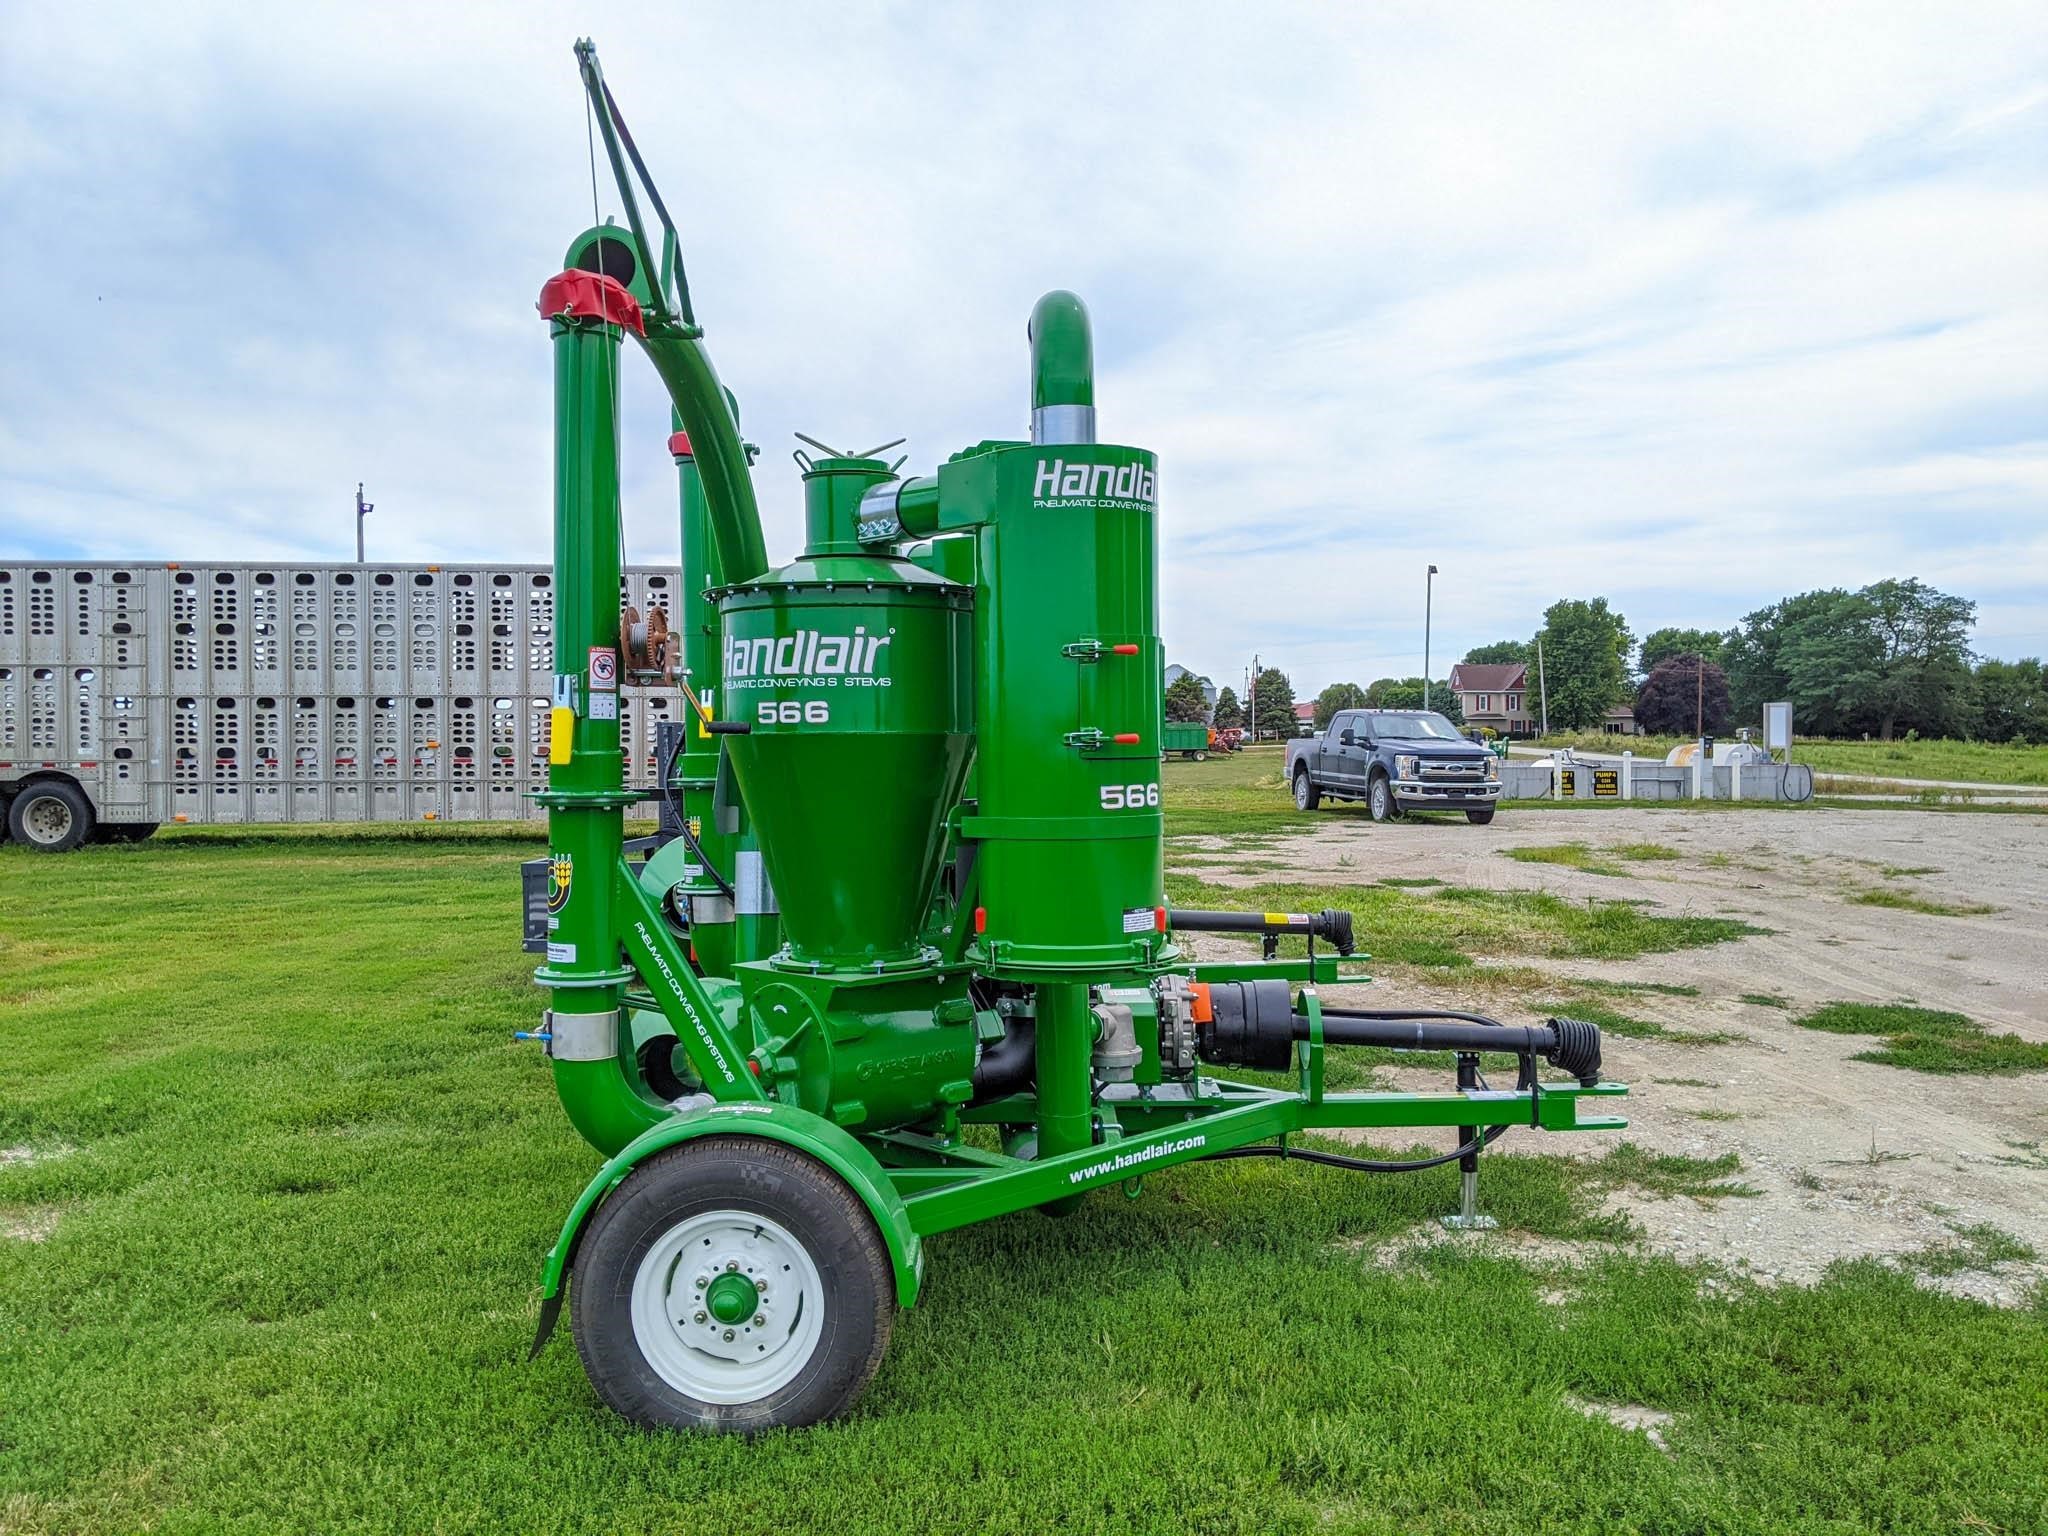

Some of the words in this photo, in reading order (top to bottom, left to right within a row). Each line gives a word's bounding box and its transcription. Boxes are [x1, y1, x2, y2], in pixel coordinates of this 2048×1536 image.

[1033, 499, 1097, 508] PNEUMATIC
[1098, 499, 1147, 512] CONVEYING
[757, 678, 825, 688] CONVEYING
[758, 700, 829, 724] 566
[1100, 783, 1159, 810] 566
[634, 921, 673, 979] PNEUMATIC
[668, 978, 707, 1036] CONVEYING
[703, 1035, 735, 1083] SYSTEMS
[1069, 1135, 1206, 1184] www.handlair.com
